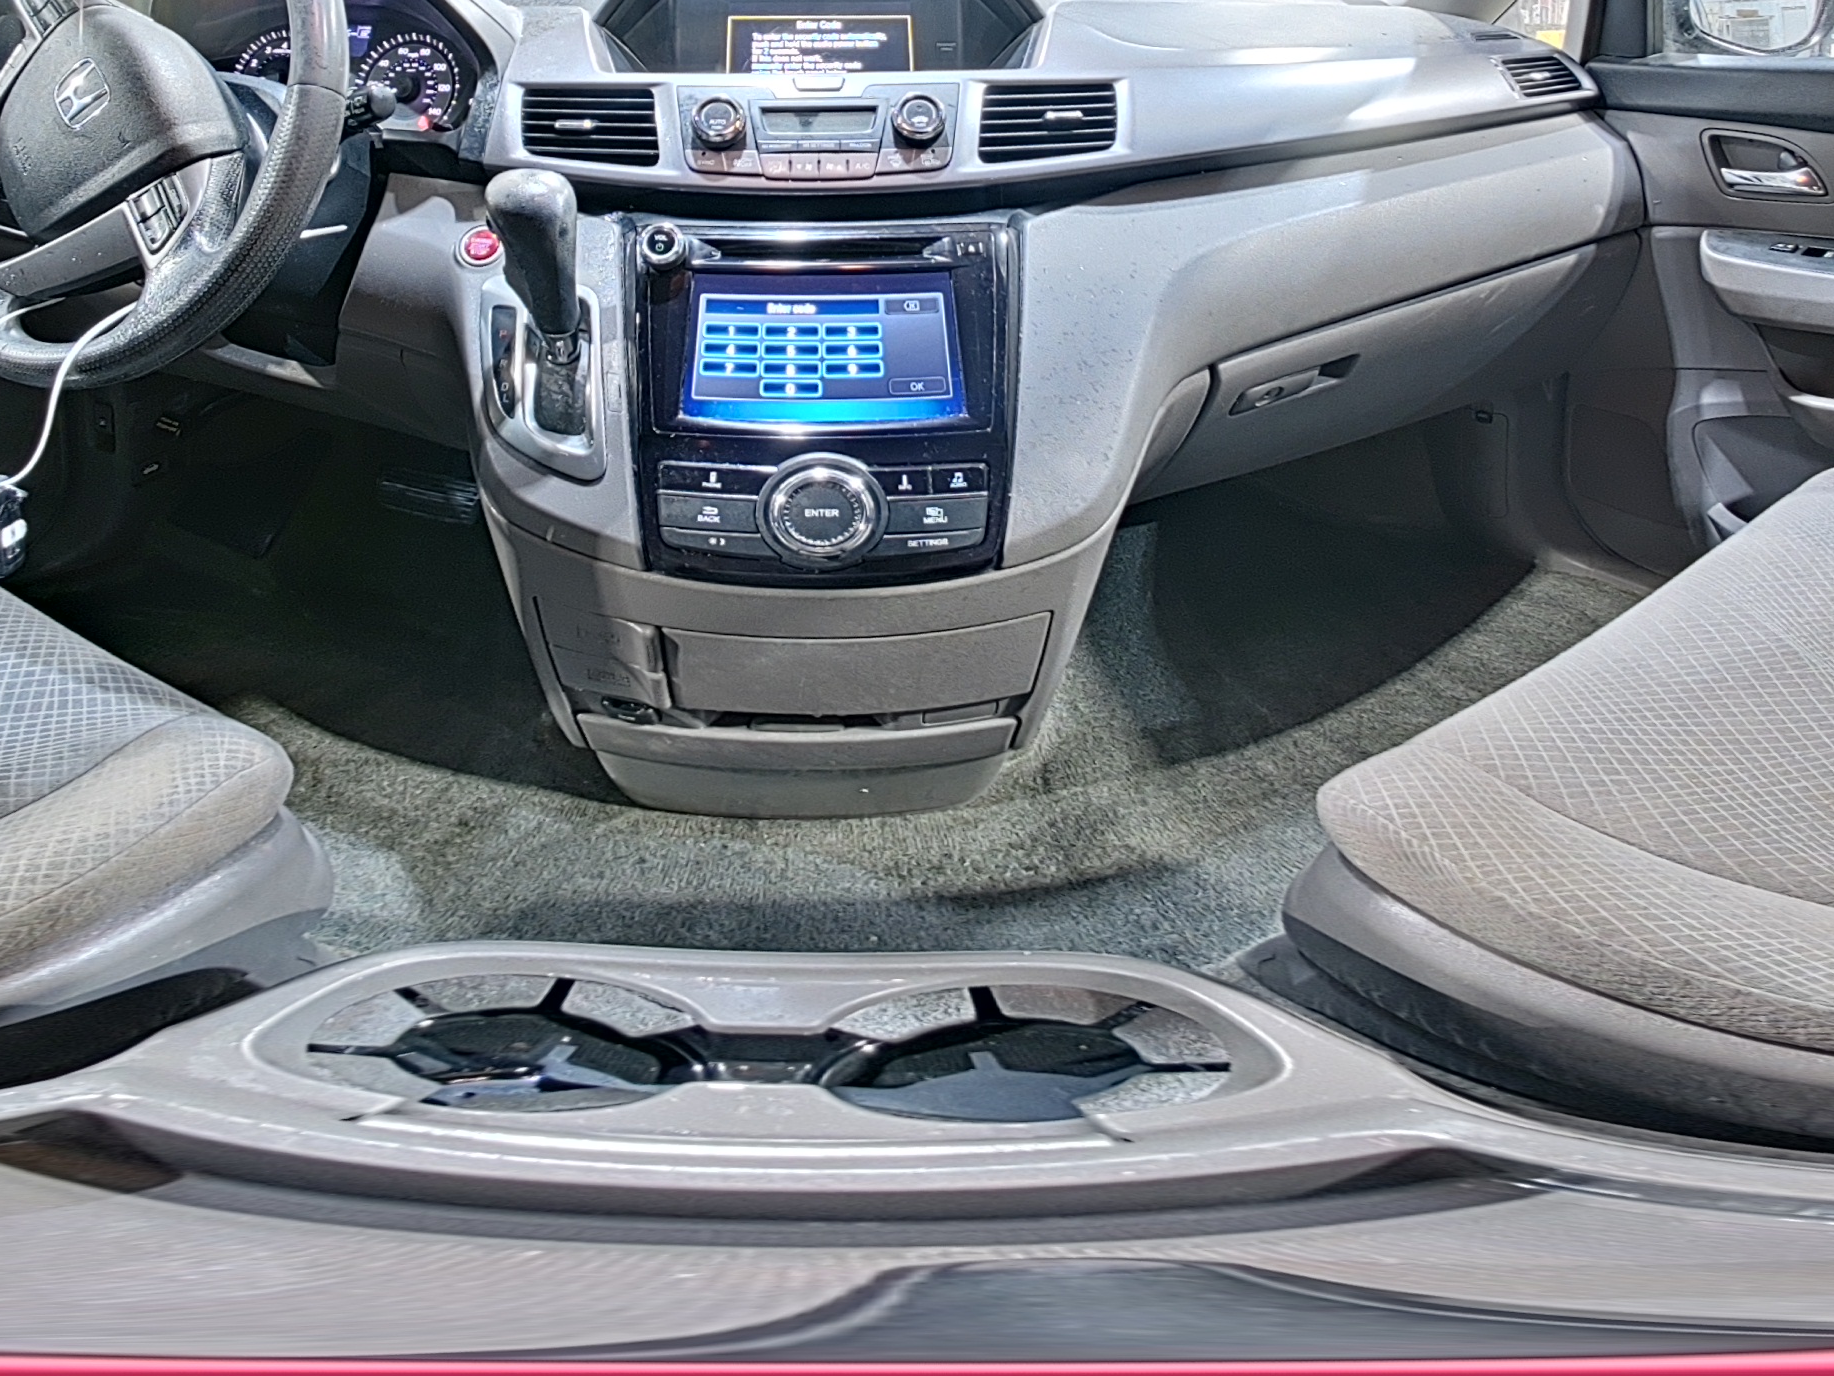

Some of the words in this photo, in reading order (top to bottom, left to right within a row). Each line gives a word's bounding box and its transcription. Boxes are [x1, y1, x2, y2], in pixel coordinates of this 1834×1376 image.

[854, 162, 870, 170] A/C
[767, 302, 791, 315] Enter
[792, 303, 816, 315] code
[499, 329, 507, 338] P
[728, 325, 735, 337] 1
[787, 326, 796, 338] 2
[847, 326, 856, 338] 3
[726, 344, 735, 356] 4
[847, 344, 857, 357] 6
[725, 362, 734, 374] 7
[847, 363, 858, 376] 9
[501, 382, 509, 391] D
[785, 382, 796, 395] 0
[909, 381, 925, 391] OK
[502, 393, 509, 403] L
[697, 514, 721, 524] BACK
[804, 509, 840, 518] ENTER
[923, 515, 948, 524] MENU
[907, 538, 949, 547] SETTINGS
